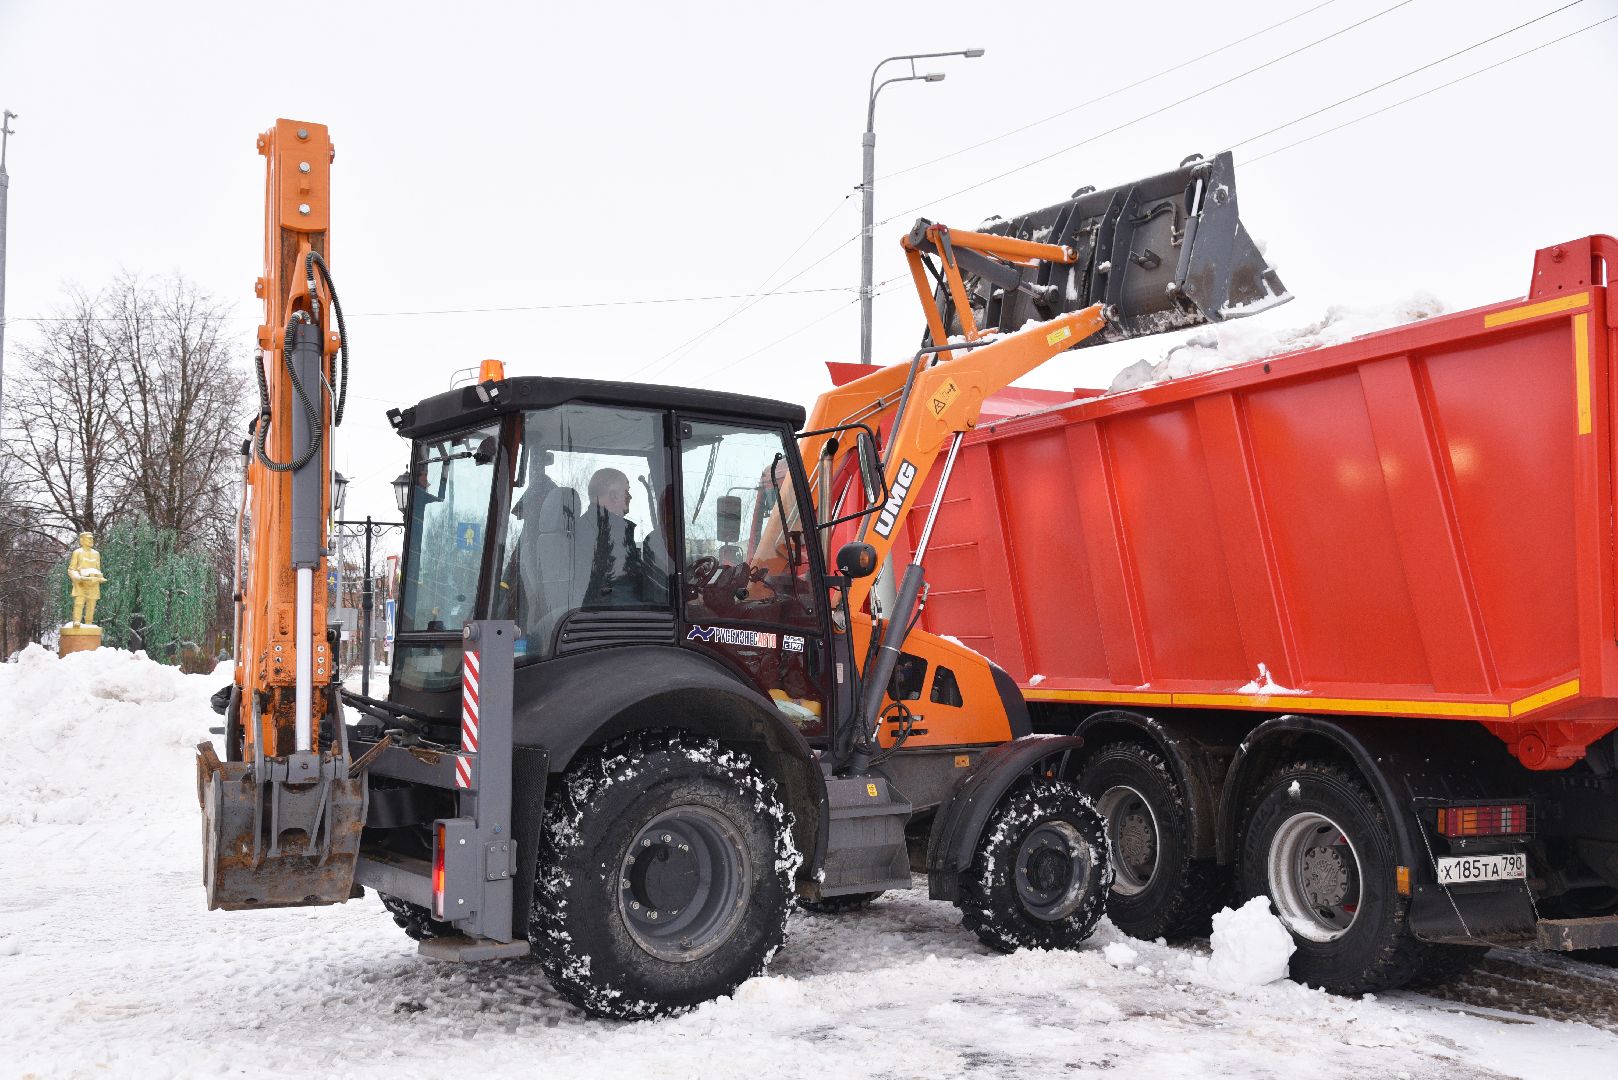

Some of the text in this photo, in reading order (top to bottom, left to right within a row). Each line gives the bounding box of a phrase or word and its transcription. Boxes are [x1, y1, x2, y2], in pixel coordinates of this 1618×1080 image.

[874, 462, 915, 536] UMG
[1444, 856, 1522, 879] Х185ТА 790
